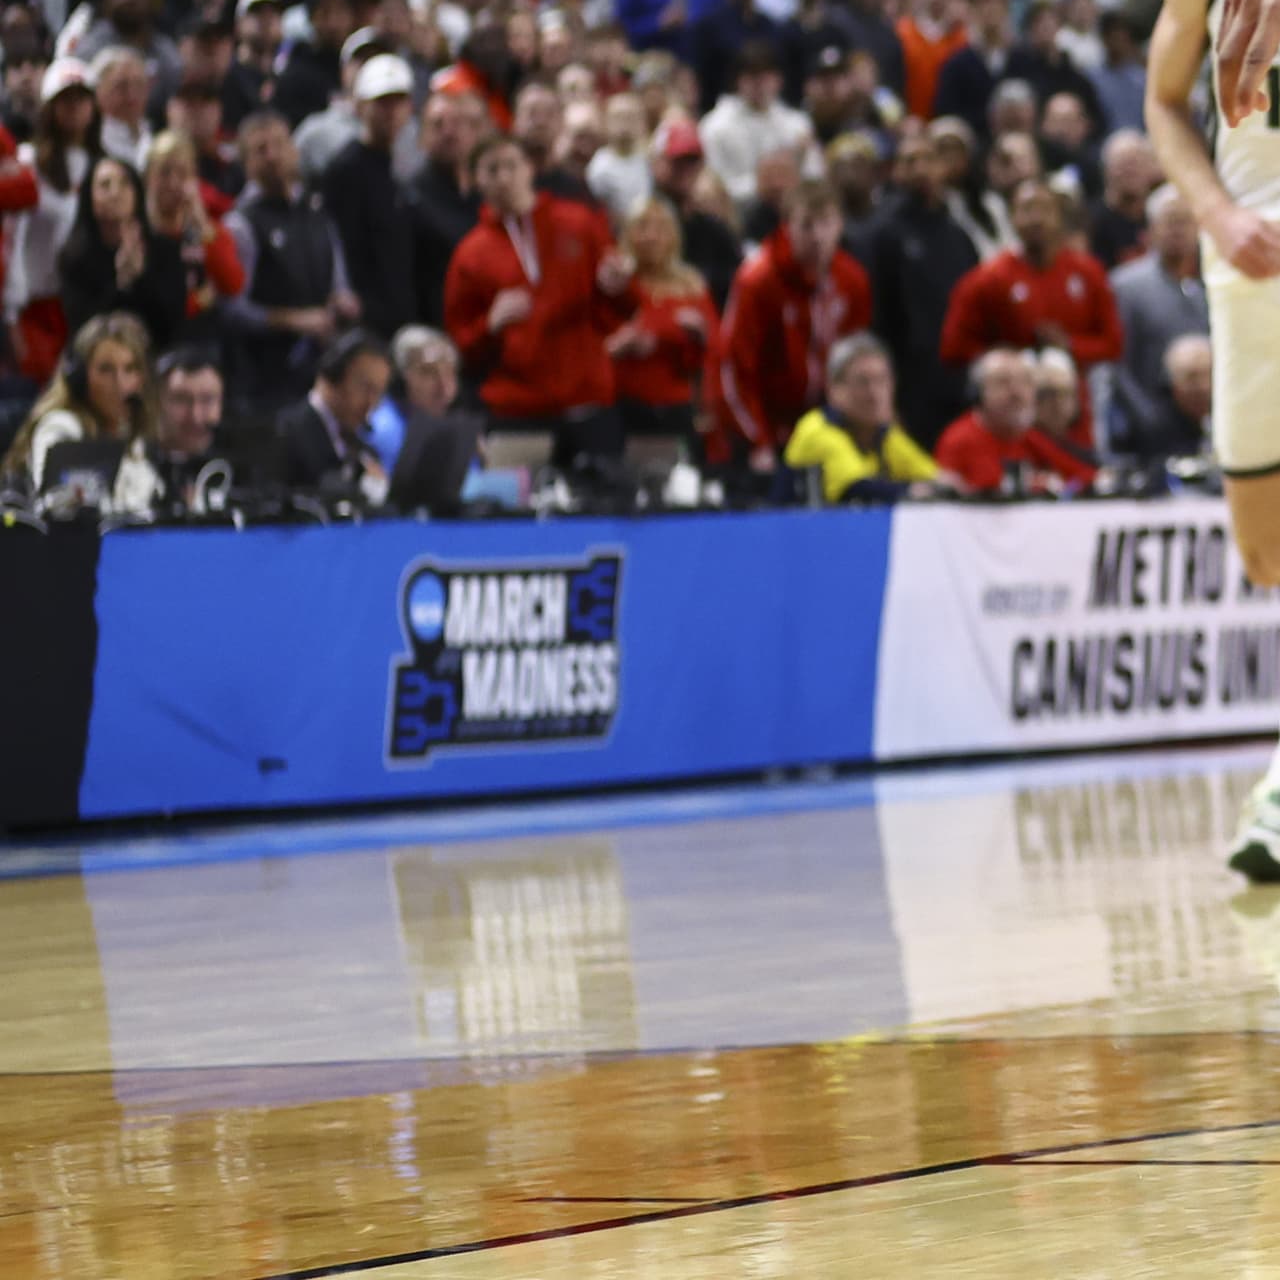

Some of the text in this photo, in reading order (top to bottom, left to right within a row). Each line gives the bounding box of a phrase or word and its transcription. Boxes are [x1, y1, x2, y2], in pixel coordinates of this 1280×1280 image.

[1088, 524, 1227, 608] METRO
[444, 572, 567, 648] MARCH
[458, 641, 618, 721] MADNESS
[1011, 630, 1206, 720] CANISIUS
